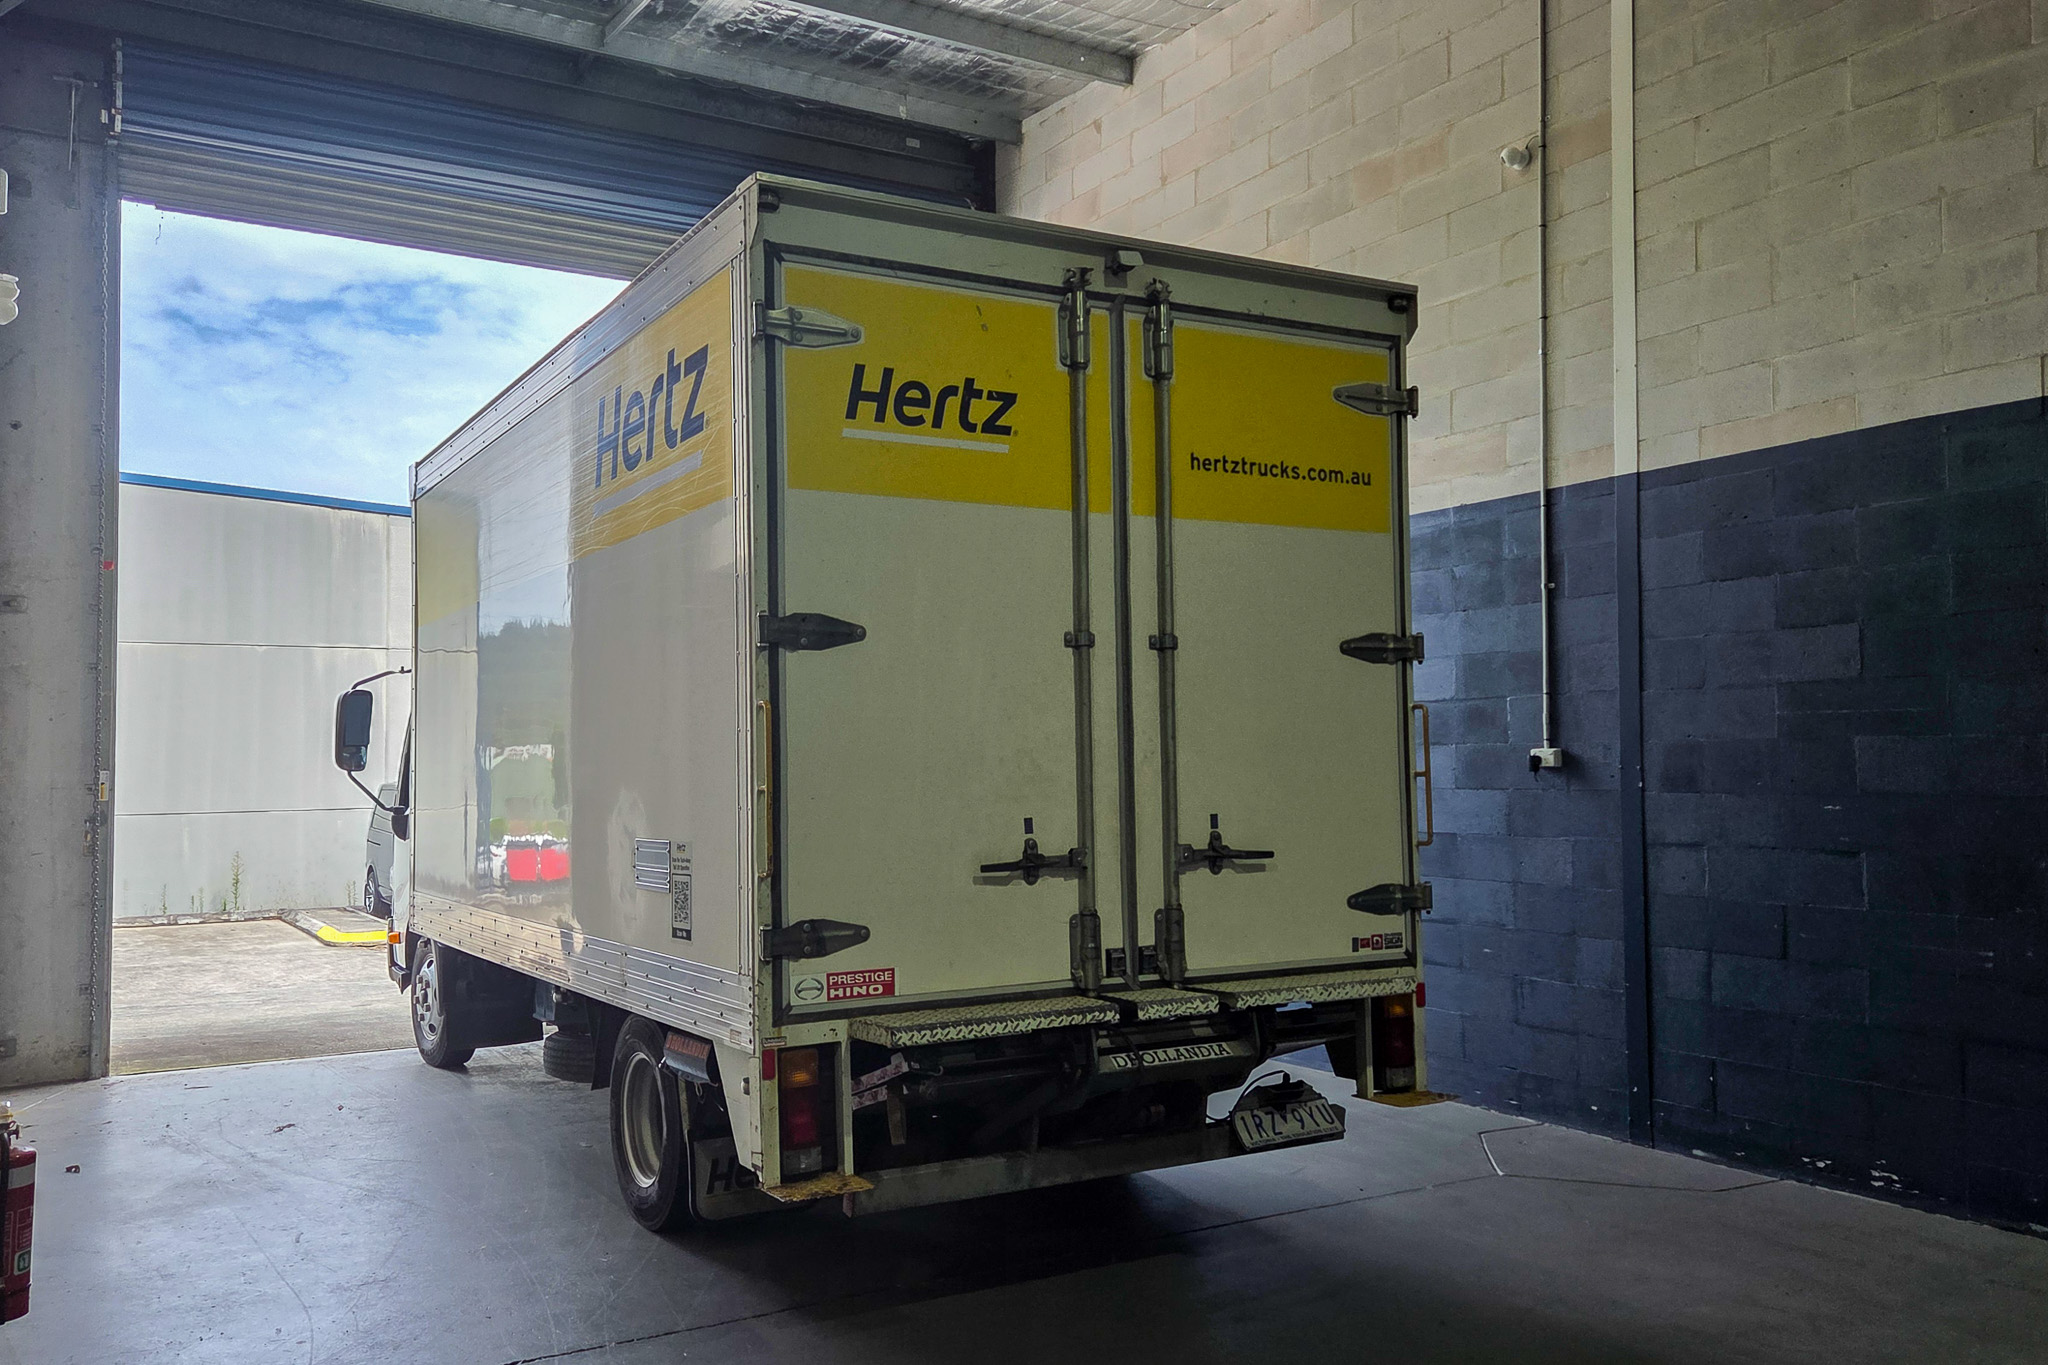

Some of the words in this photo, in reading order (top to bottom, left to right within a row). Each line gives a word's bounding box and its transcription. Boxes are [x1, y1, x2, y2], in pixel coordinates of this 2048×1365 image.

[594, 343, 710, 488] Hertz
[844, 363, 1018, 437] Hertz
[1190, 452, 1372, 486] hertztrucks.com.au
[829, 970, 893, 985] PRESTIGE
[829, 984, 884, 998] HINO
